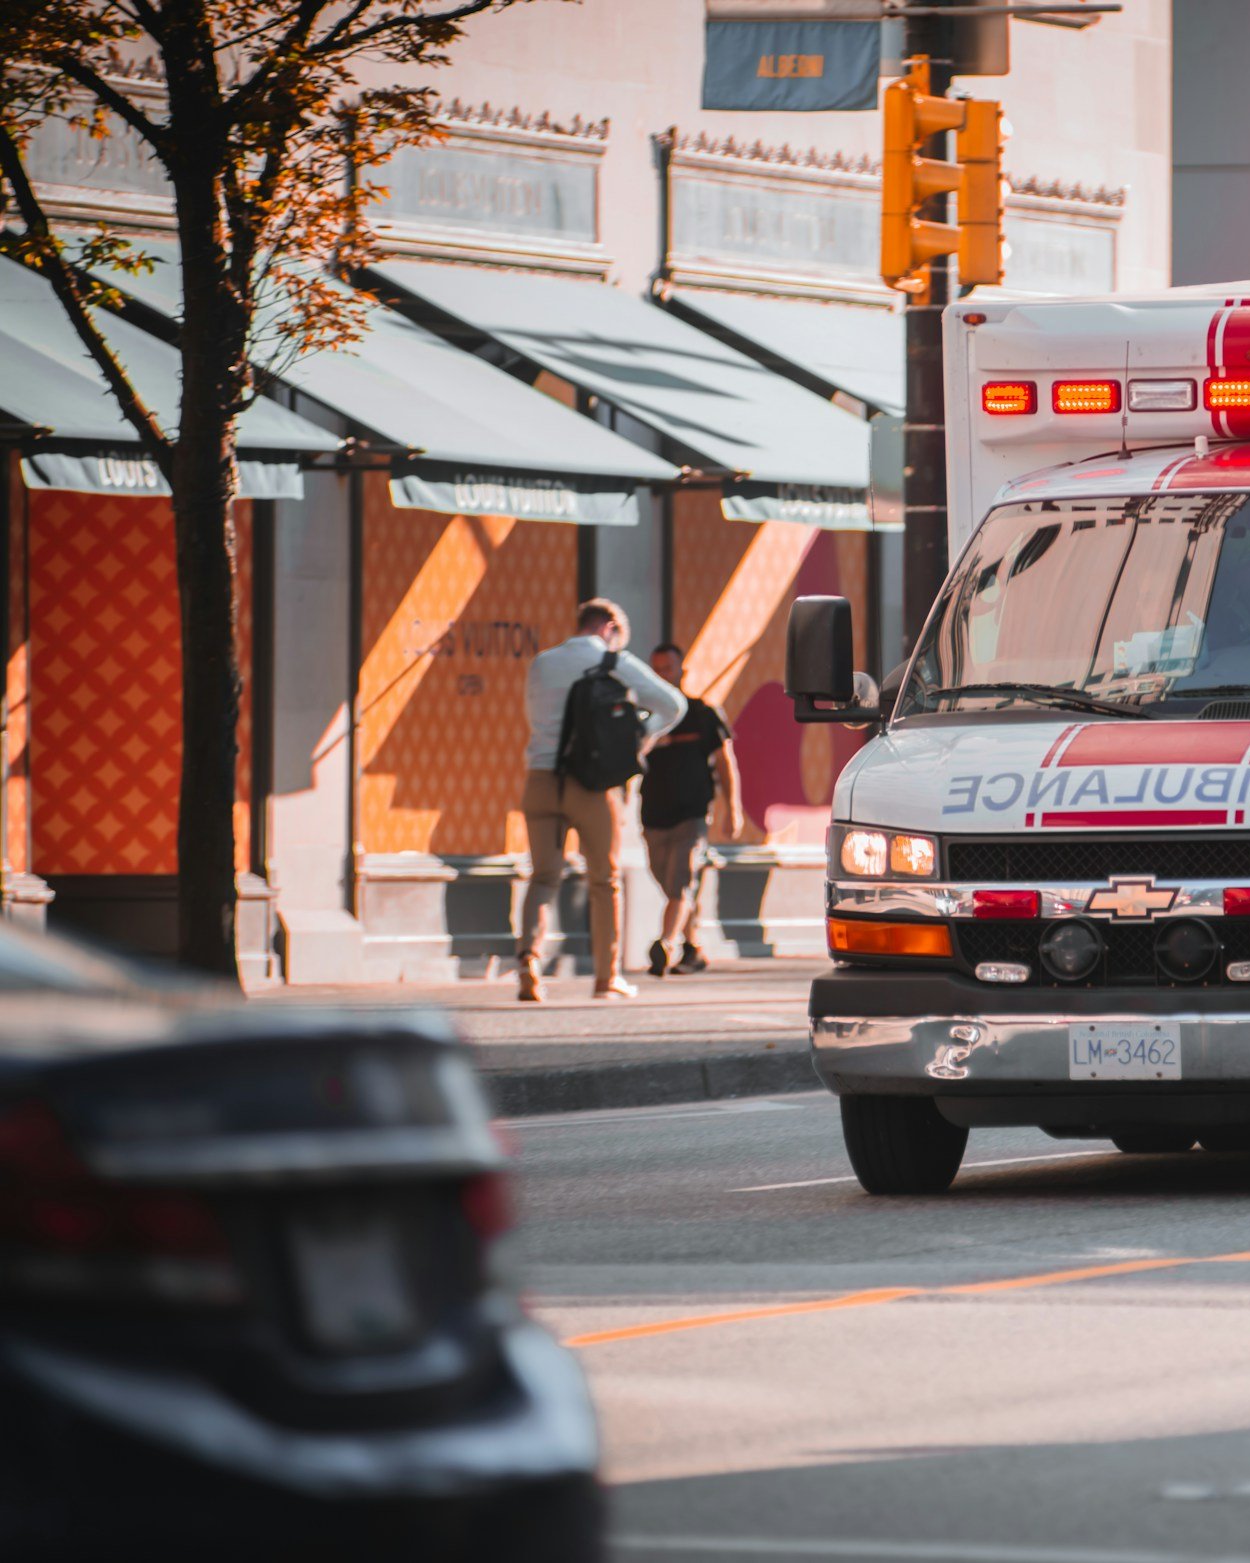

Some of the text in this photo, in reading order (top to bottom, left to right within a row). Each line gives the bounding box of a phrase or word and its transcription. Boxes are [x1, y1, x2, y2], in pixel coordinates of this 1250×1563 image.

[99, 454, 158, 488] LOUIS
[454, 473, 577, 516] LOUIS VUITTON
